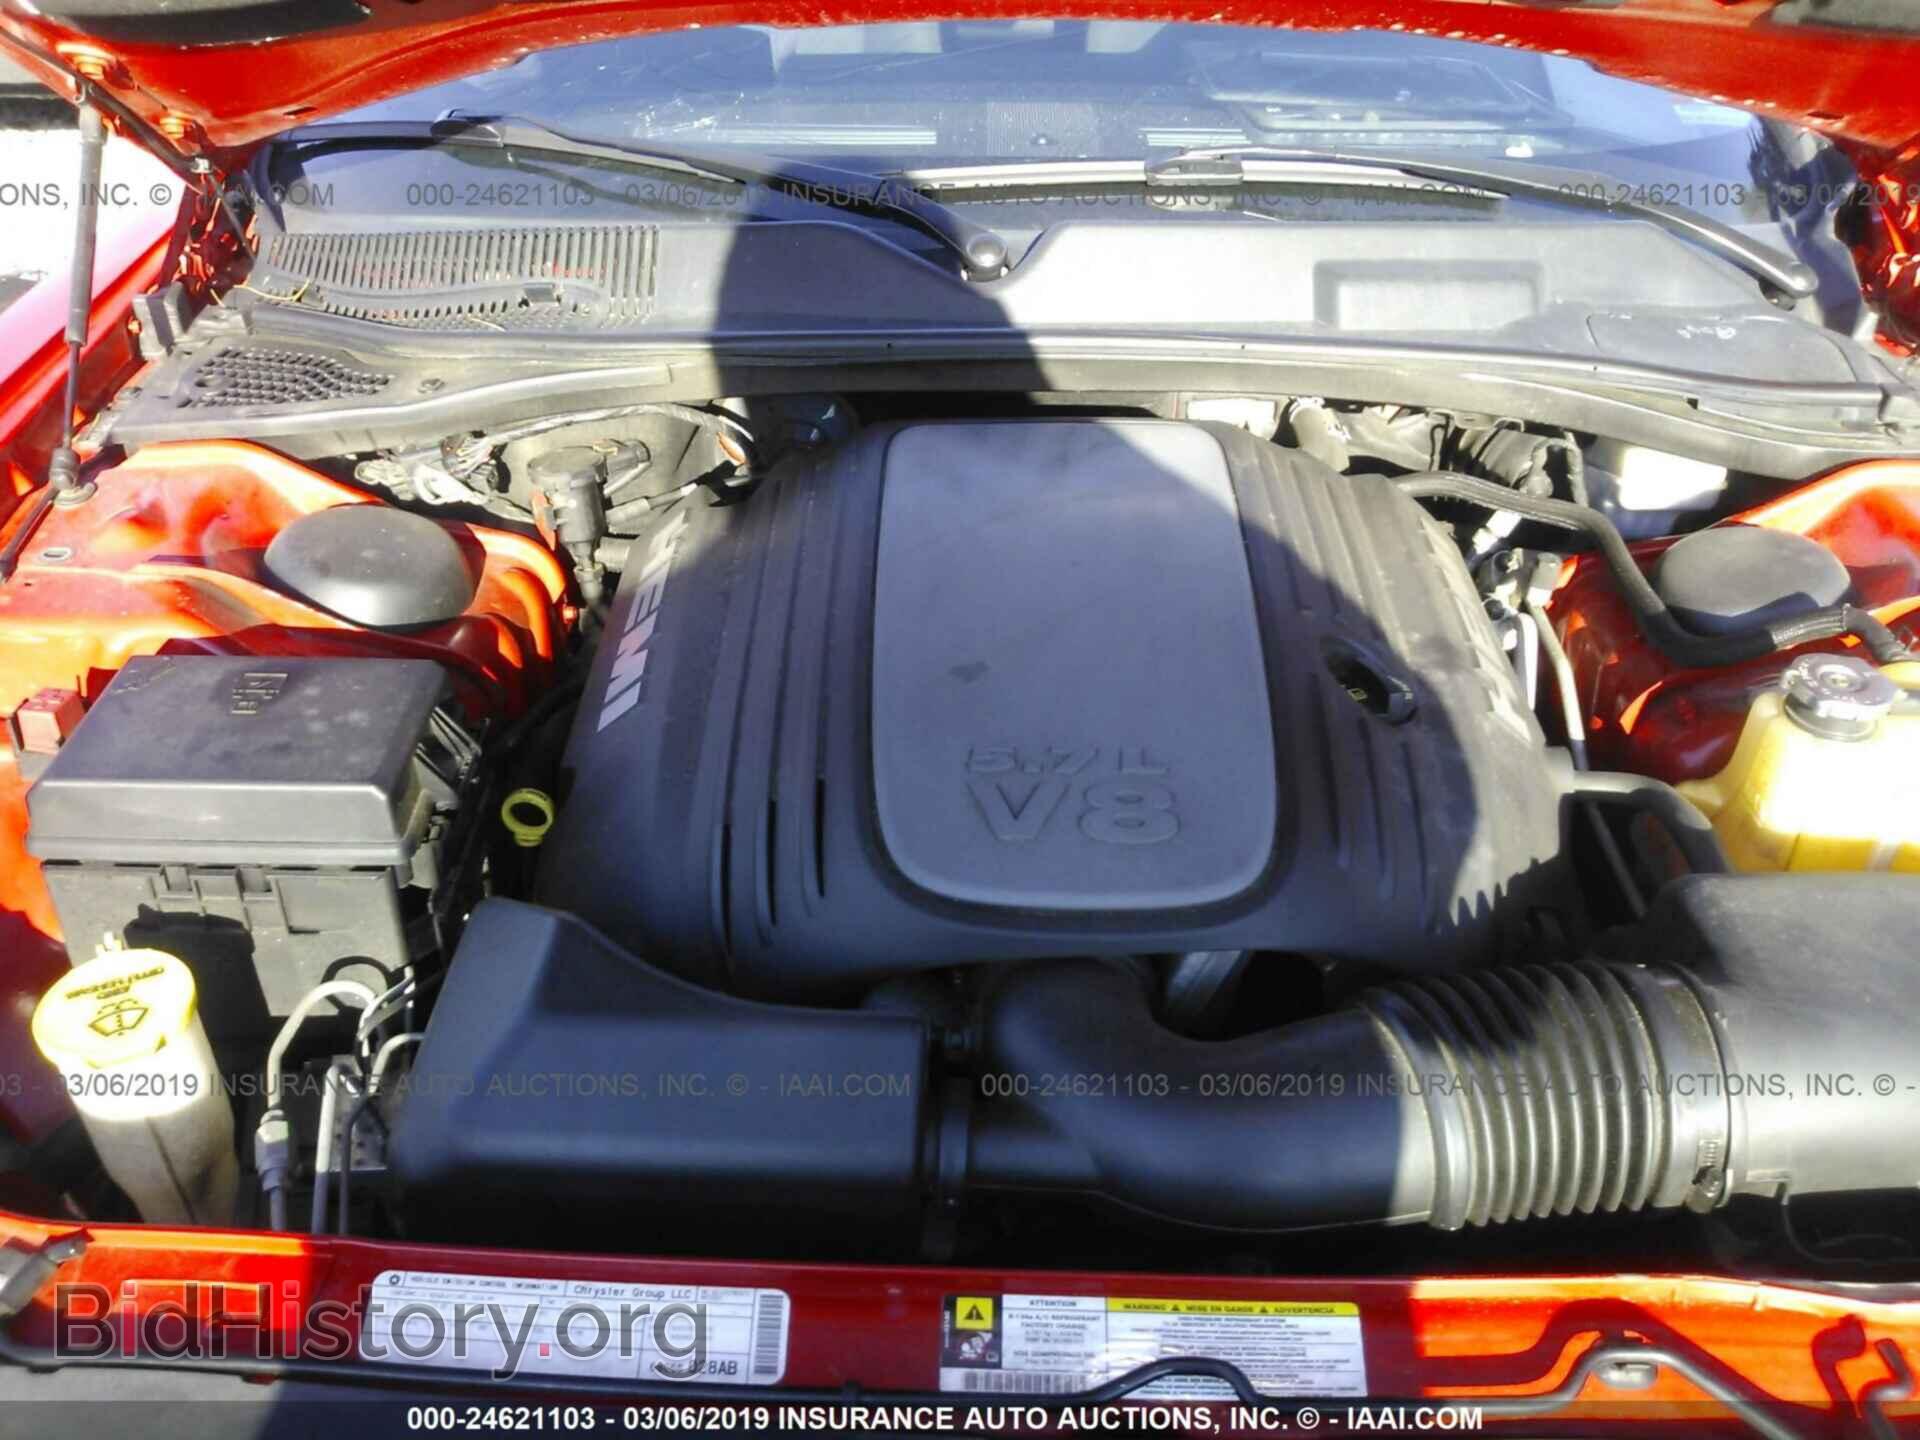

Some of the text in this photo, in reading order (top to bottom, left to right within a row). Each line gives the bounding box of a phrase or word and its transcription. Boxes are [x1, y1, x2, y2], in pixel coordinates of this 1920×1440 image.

[597, 509, 688, 733] HEMI
[964, 780, 1183, 846] V8
[574, 1284, 625, 1298] Chrysler
[632, 1286, 665, 1300] Group
[671, 1288, 691, 1299] LLC
